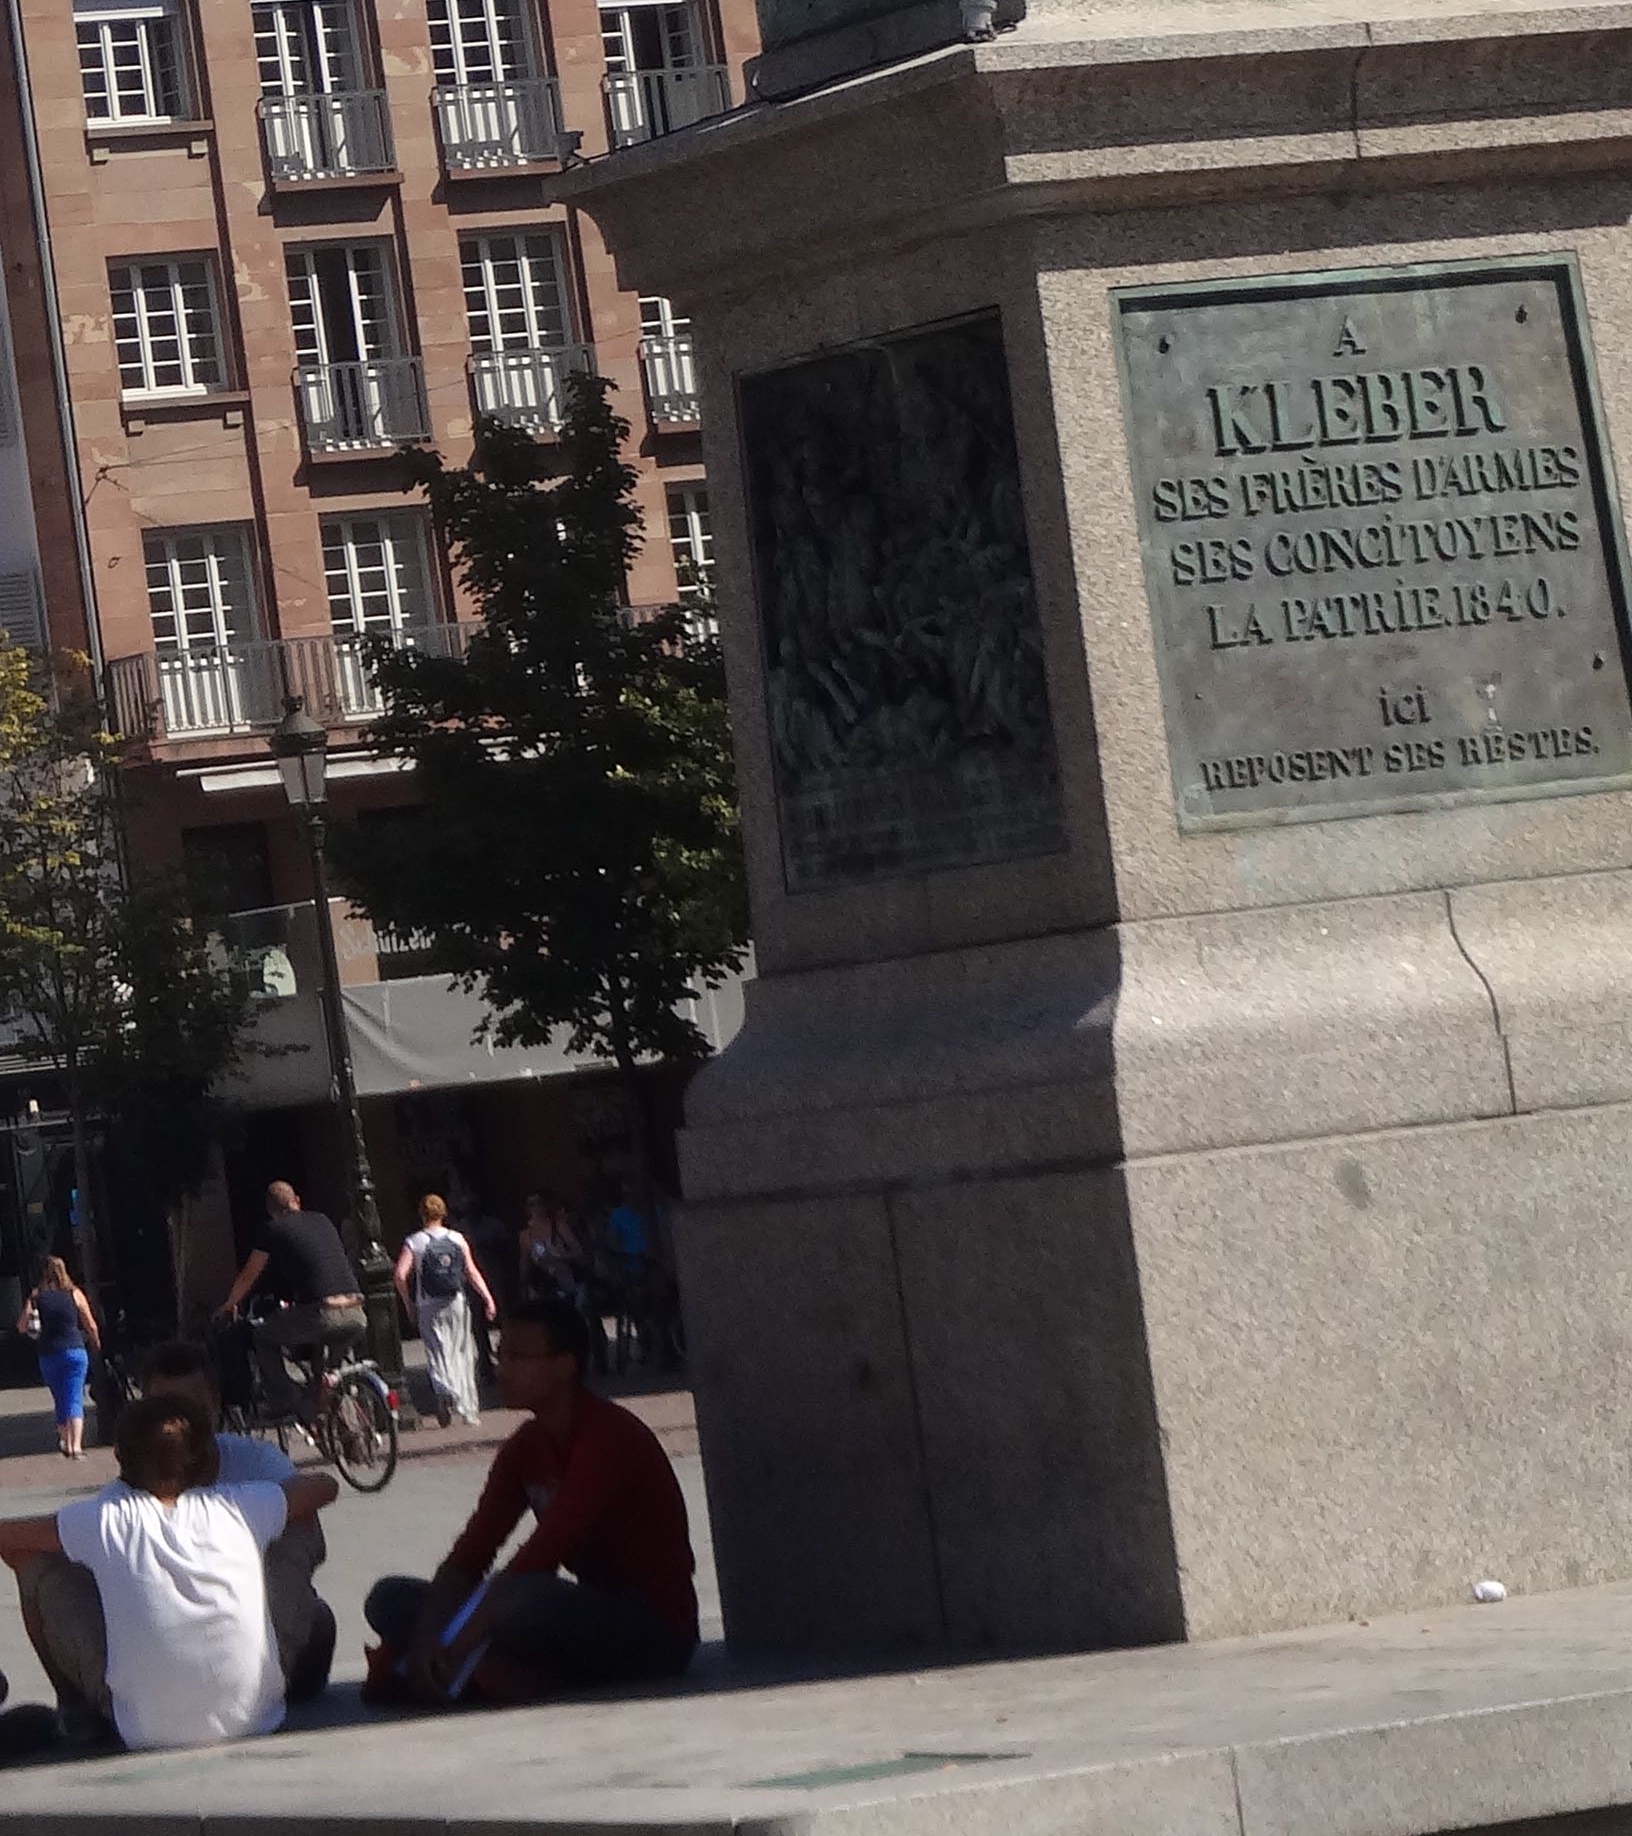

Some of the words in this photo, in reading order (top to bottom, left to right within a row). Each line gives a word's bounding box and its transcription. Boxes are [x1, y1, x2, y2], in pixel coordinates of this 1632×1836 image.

[1332, 314, 1367, 357] A
[1205, 365, 1507, 458] KLEBER
[1152, 474, 1230, 523] SES
[1239, 455, 1403, 518] FRÈRES
[1170, 537, 1254, 586] SES
[1204, 602, 1273, 651] LA
[1199, 746, 1374, 792] REPOSENT
[1384, 738, 1447, 773] SES
